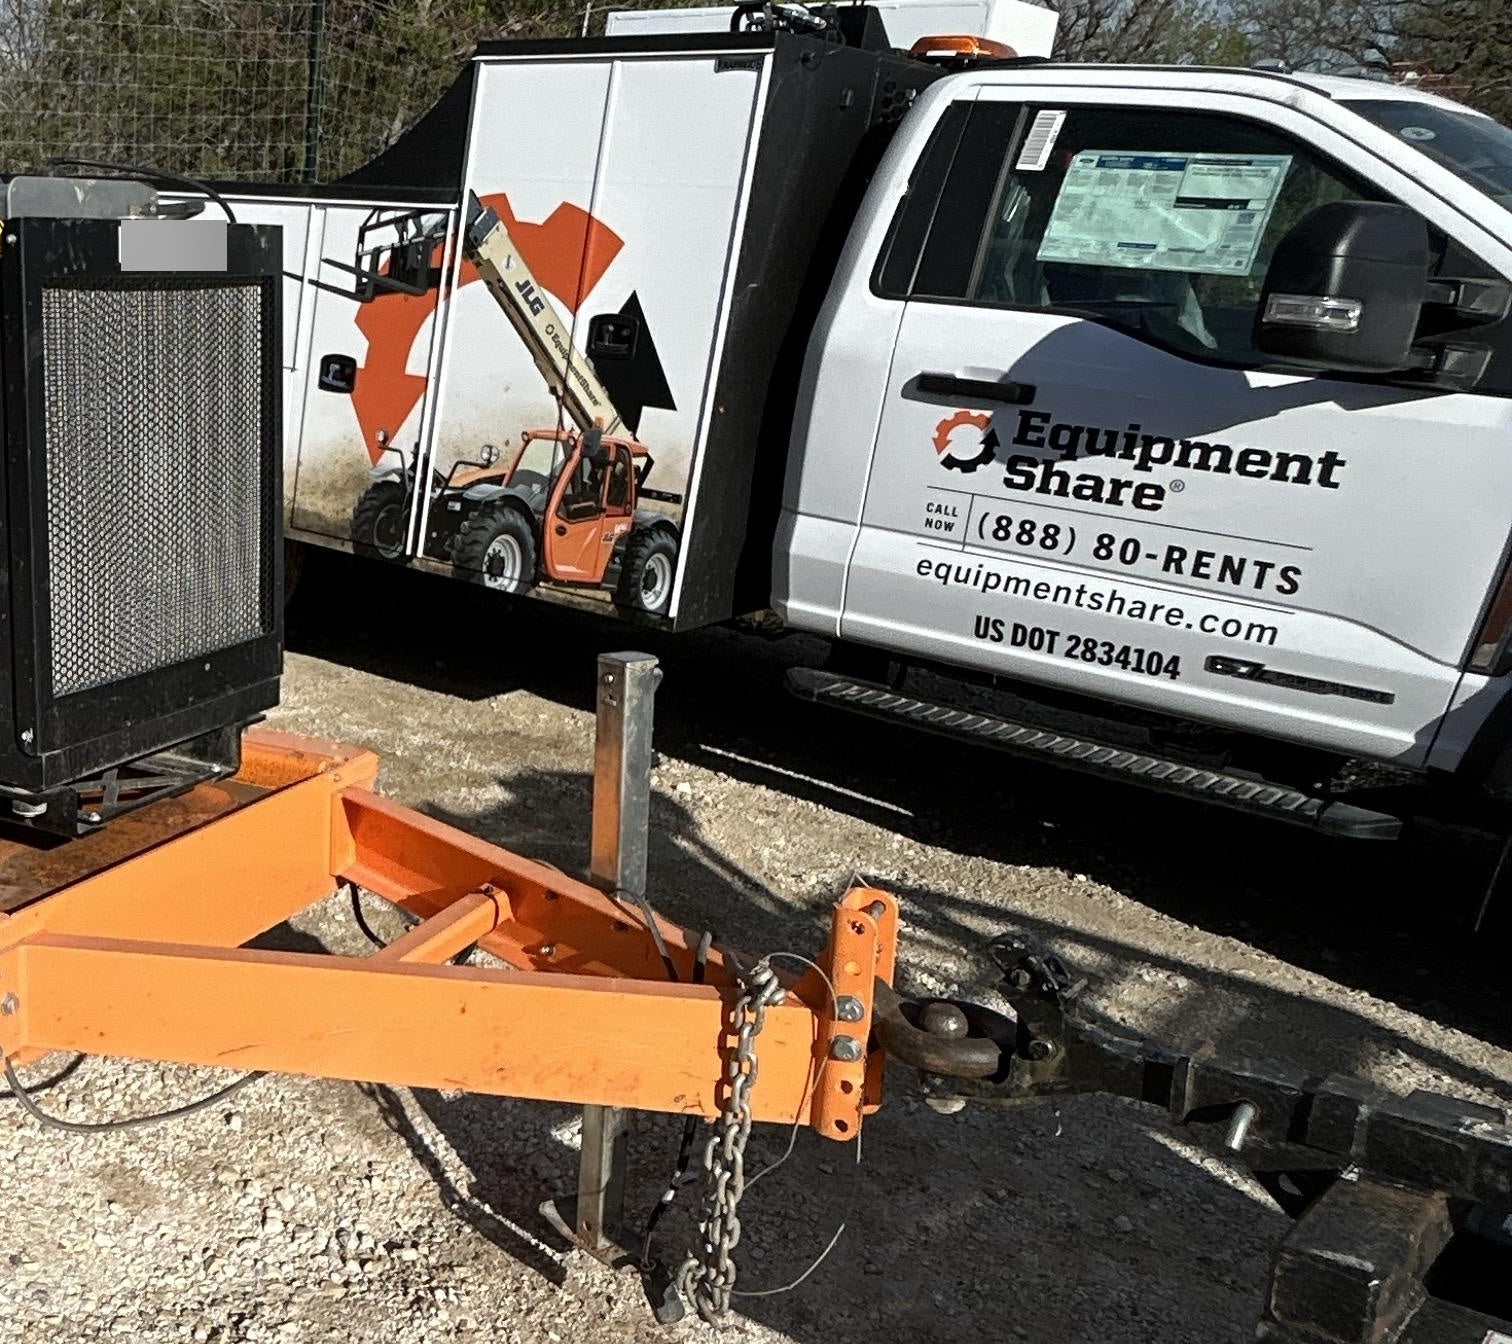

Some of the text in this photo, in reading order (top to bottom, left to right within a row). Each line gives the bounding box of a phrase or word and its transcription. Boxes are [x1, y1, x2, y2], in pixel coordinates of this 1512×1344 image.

[515, 279, 546, 316] JLG
[1012, 409, 1347, 489] Equipment
[924, 518, 955, 532] NOW
[926, 502, 958, 517] CALL
[977, 512, 1303, 596] (888) 80-RENTS
[916, 558, 1279, 646] equipmentshare.com
[973, 615, 1181, 680] US DOT 2834104
